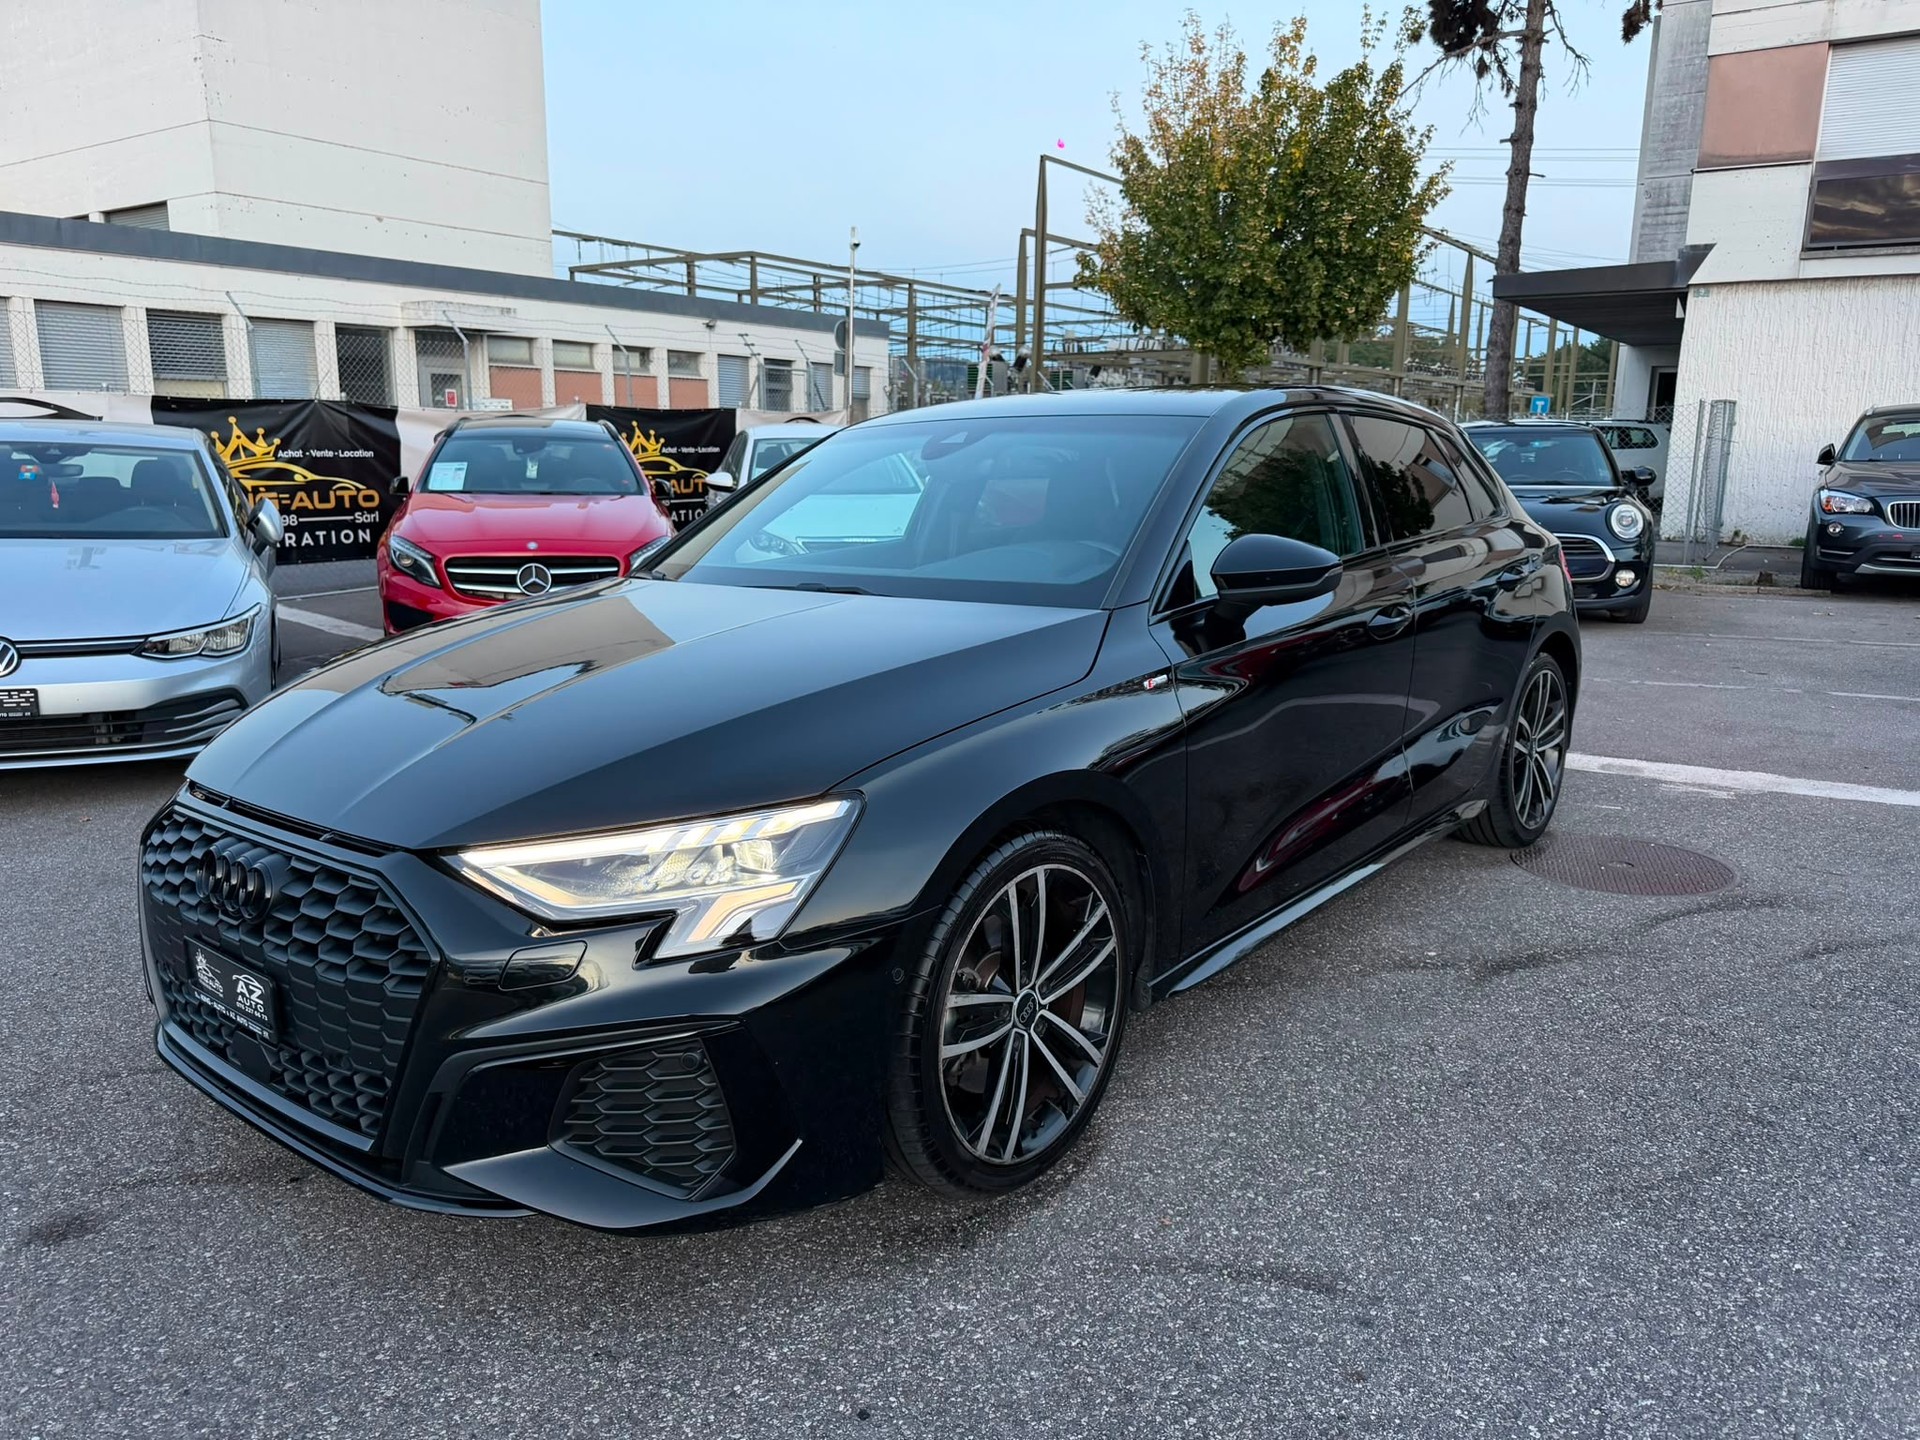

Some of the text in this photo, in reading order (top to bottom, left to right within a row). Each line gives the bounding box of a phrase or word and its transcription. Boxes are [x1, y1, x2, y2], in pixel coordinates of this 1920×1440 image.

[277, 449, 303, 458] Achat
[310, 449, 334, 458] Vente
[339, 448, 374, 458] Location
[670, 478, 705, 494] AUT
[354, 510, 380, 524] Sàrl
[671, 508, 707, 522] ATIO
[277, 528, 371, 548] RATION
[237, 980, 264, 1005] AZ
[237, 994, 265, 1013] AUTO
